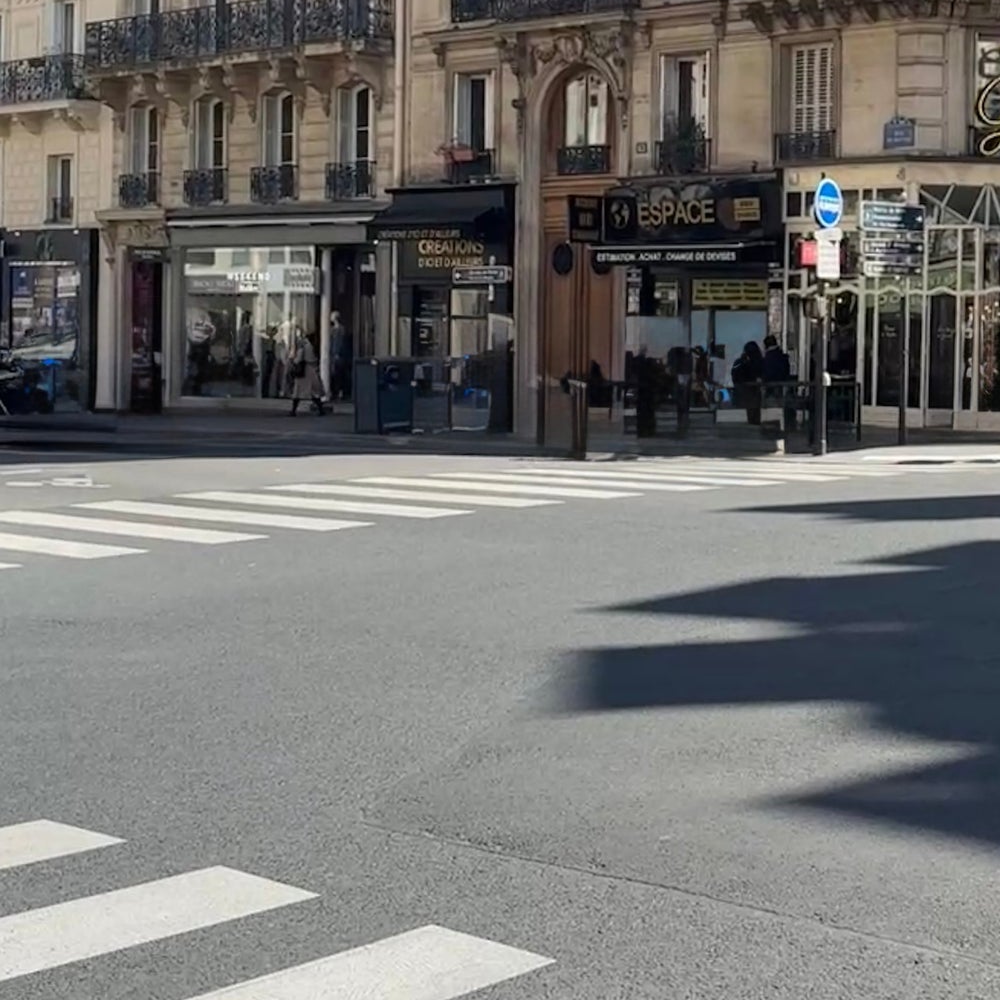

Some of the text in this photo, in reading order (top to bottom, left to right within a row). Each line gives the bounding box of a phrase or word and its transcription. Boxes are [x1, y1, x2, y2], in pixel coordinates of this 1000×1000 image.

[636, 199, 716, 225] ESPACE
[596, 251, 737, 262] ESTIMATION ACHAT CHANGE DE DEVISES
[227, 271, 271, 281] WEEKEND
